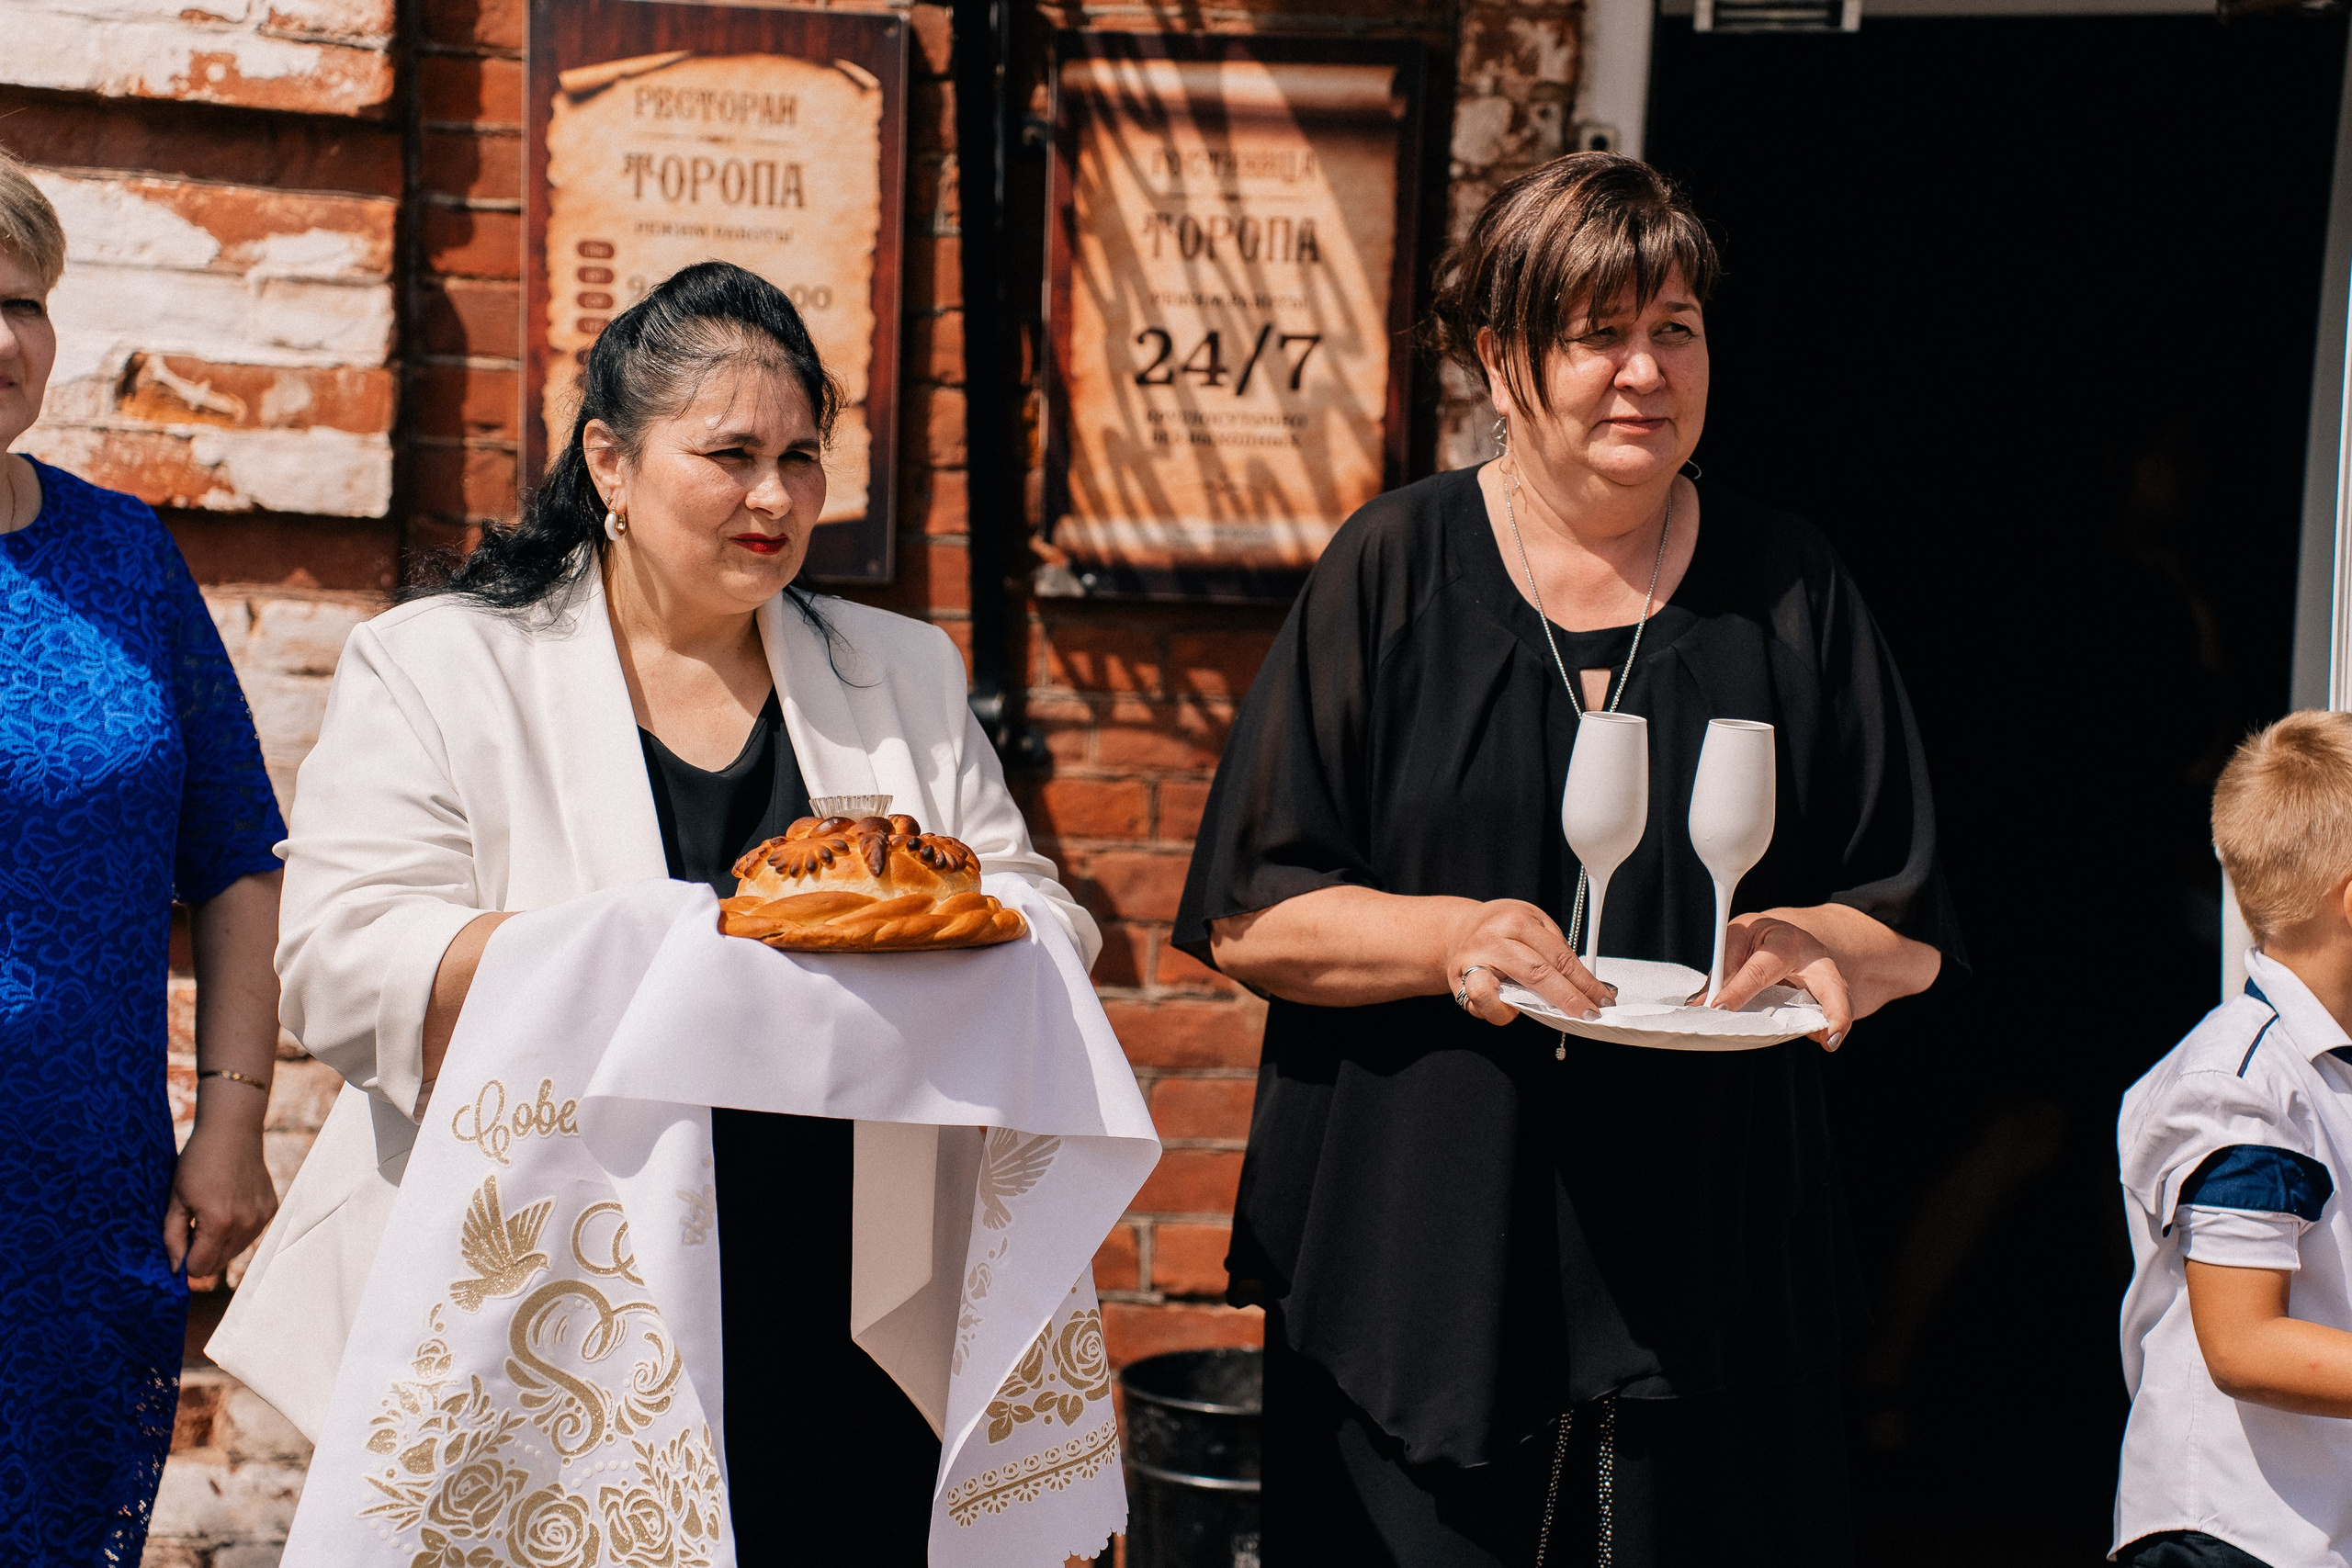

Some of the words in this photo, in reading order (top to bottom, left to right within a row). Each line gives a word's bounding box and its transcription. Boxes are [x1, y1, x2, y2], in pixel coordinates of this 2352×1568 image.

[633, 85, 798, 126] РЕСТОРАН
[623, 152, 807, 209] ТОРОПА
[1144, 212, 1320, 264] ТОРОПА
[1135, 323, 1323, 397] 24/7
[451, 1077, 580, 1166] Сове
